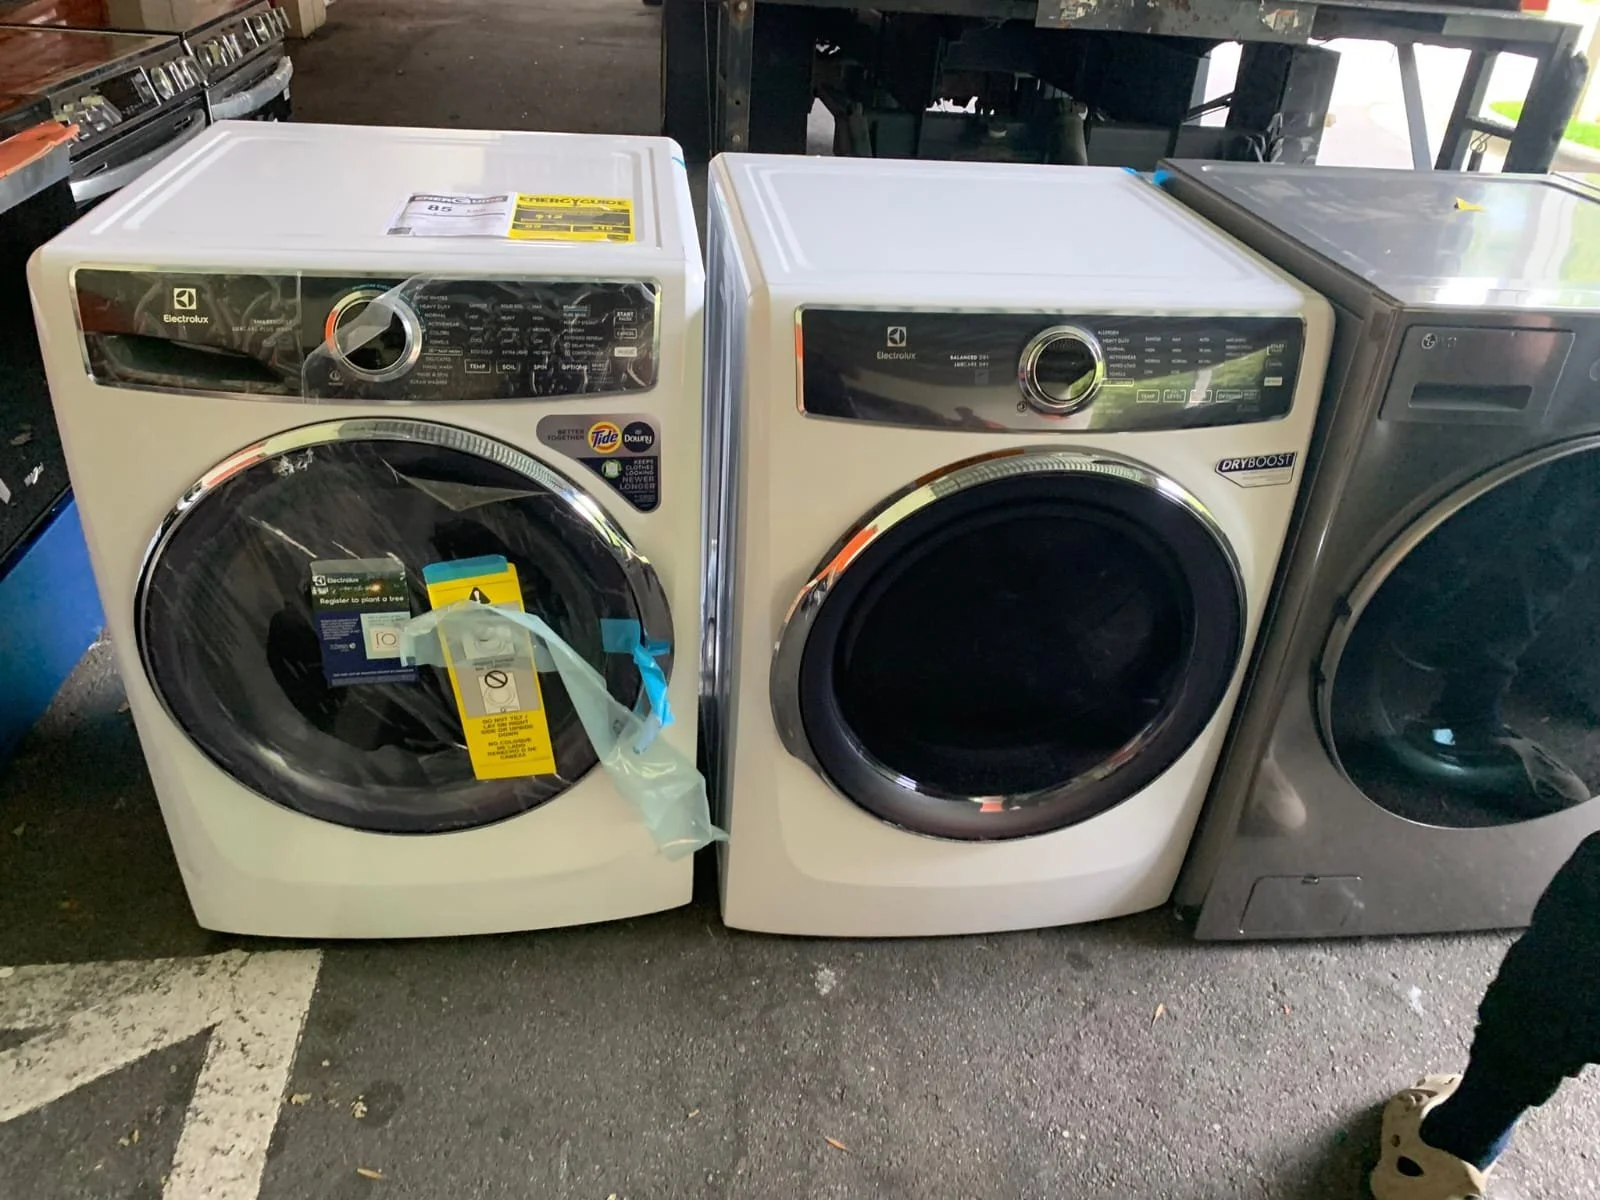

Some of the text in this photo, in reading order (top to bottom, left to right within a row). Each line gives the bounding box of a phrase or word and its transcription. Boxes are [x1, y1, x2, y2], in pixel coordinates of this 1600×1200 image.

[163, 314, 209, 324] Electrolux
[876, 351, 917, 361] Electrolux
[591, 430, 620, 449] Tide
[624, 434, 653, 445] Downy
[1221, 454, 1292, 471] DRYBOOST
[320, 597, 350, 606] Register
[361, 596, 381, 604] plant
